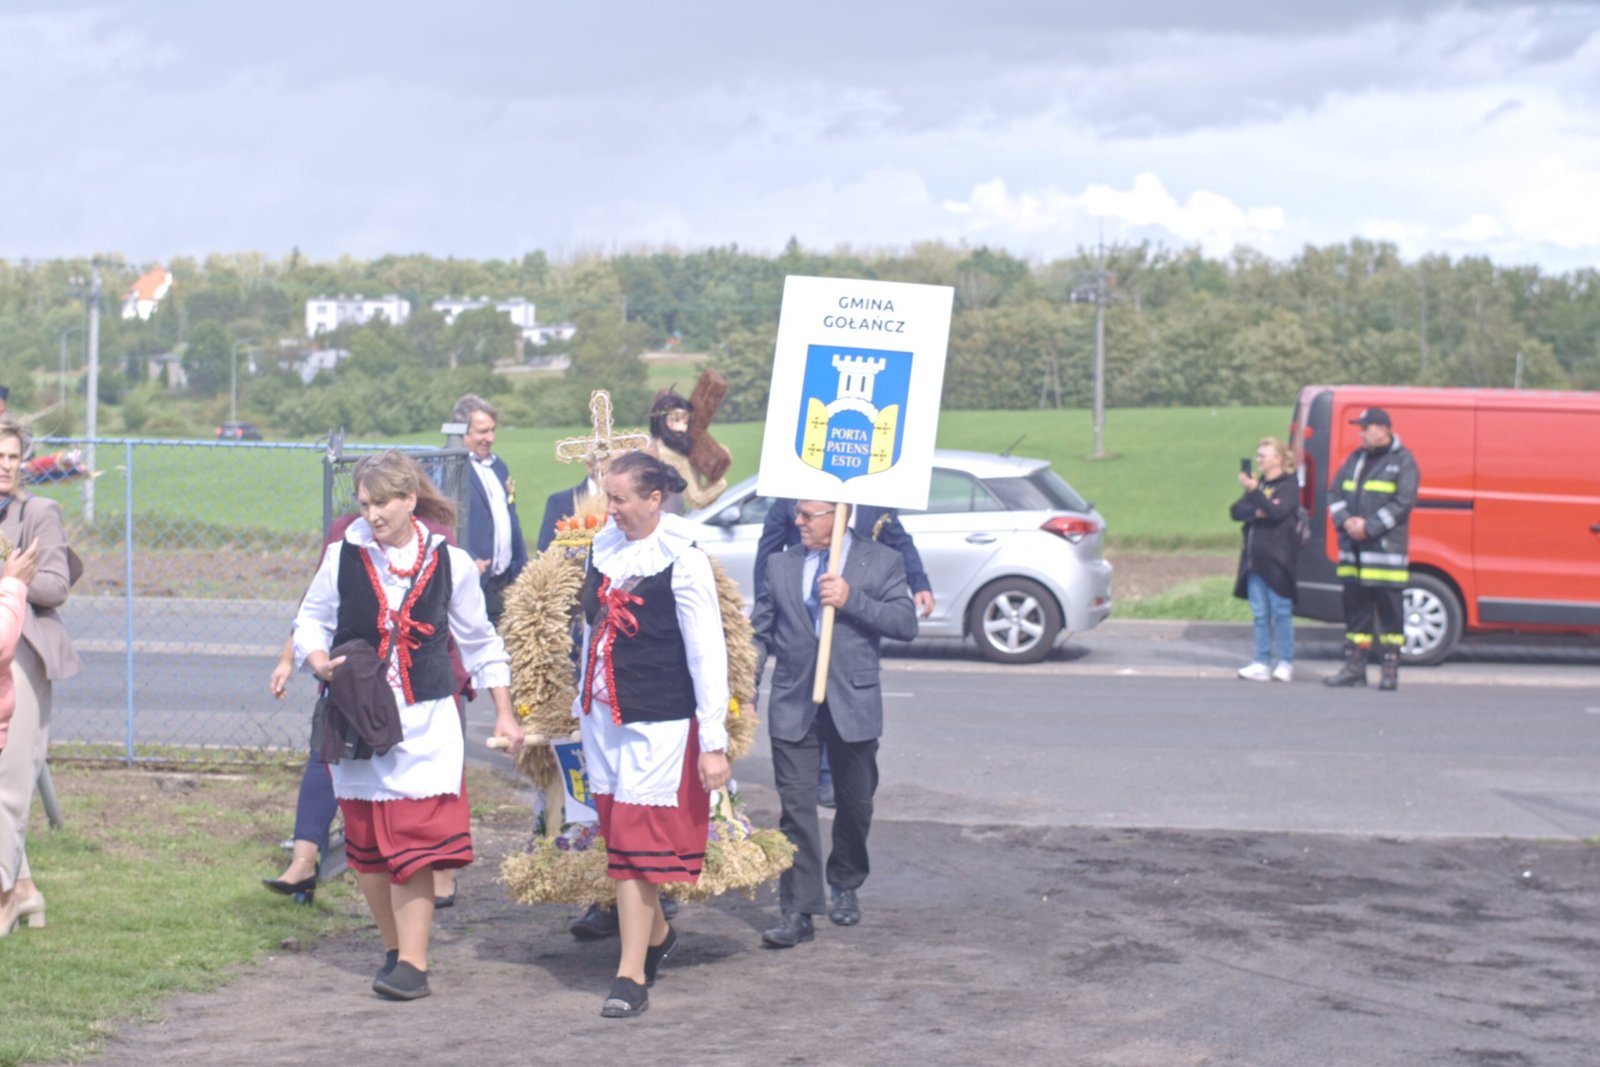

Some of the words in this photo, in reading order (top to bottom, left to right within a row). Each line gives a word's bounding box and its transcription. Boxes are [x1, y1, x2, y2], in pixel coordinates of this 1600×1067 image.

[838, 296, 894, 312] GMINA
[823, 315, 905, 333] GOŁAŃCZ
[831, 428, 867, 441] PORTA
[827, 441, 868, 455] PATENS
[831, 455, 861, 467] ESTO
